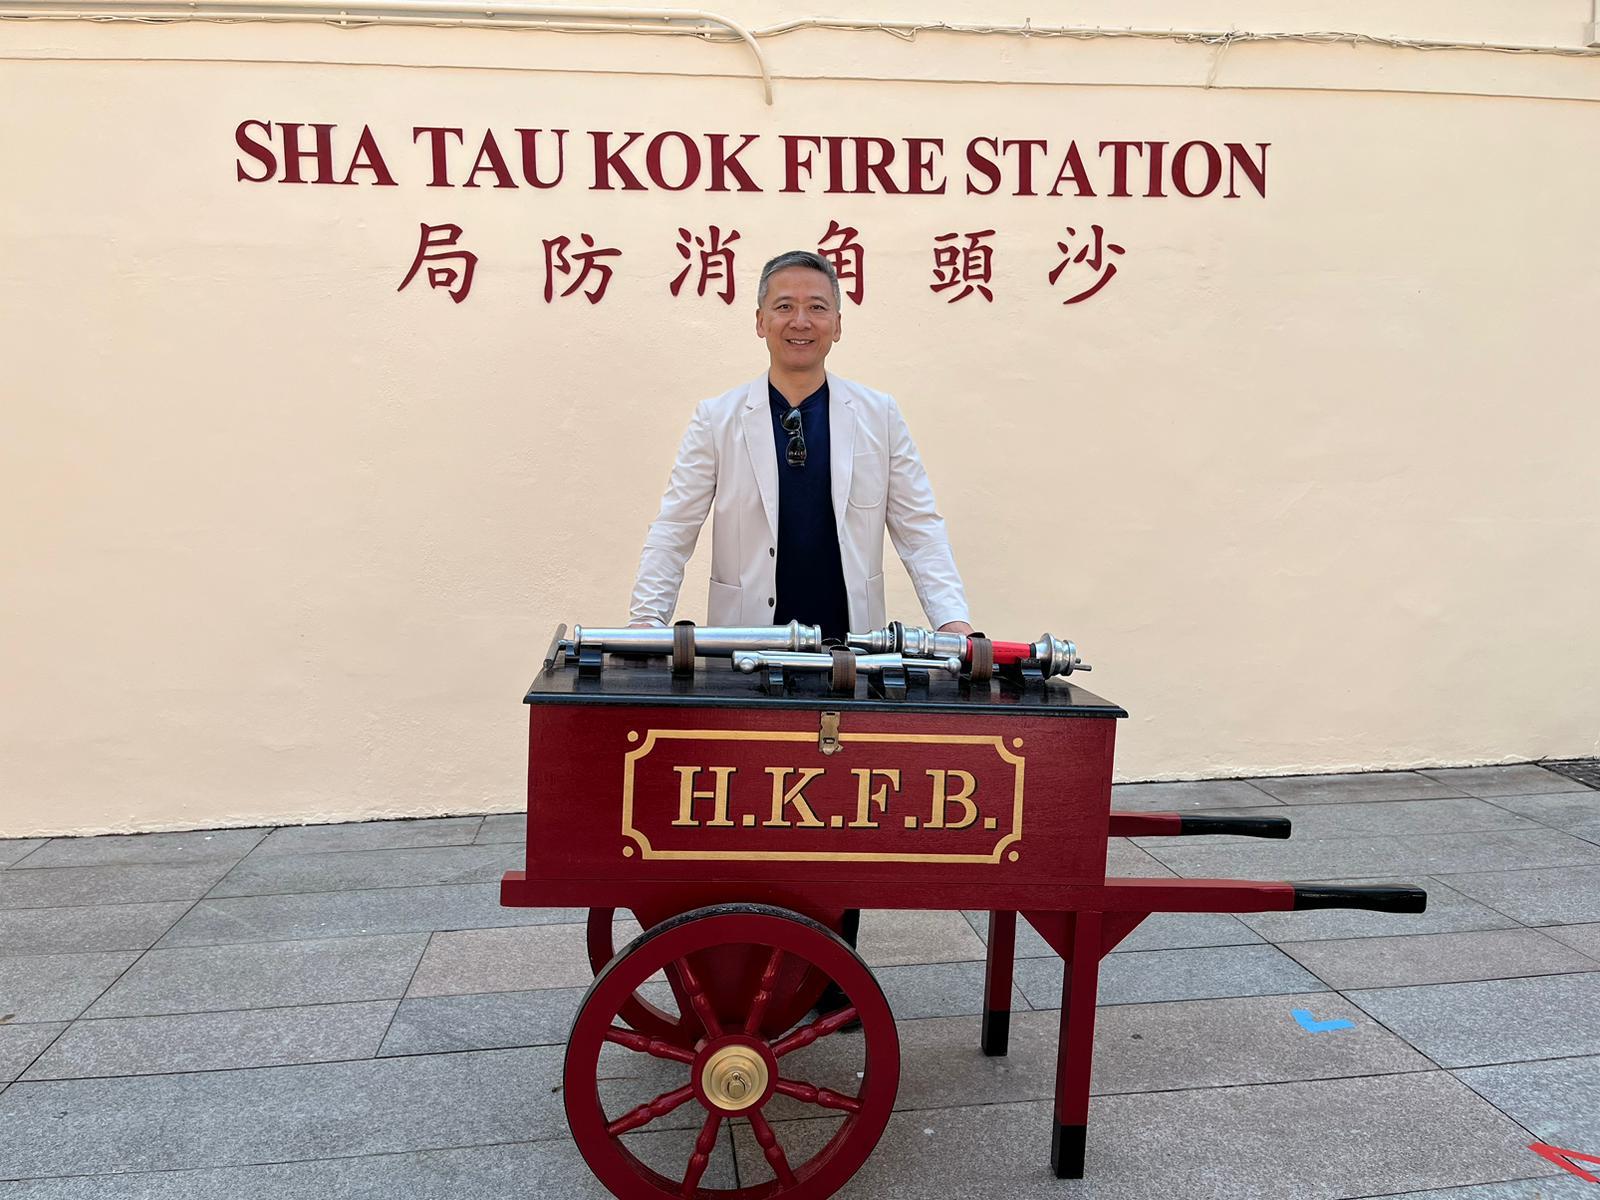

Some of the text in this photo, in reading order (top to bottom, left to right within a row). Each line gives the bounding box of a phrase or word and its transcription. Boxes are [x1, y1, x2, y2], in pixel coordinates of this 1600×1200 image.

[235, 119, 1272, 199] SHA TAU KOK FIRE STATION
[670, 764, 999, 830] H.K.F.B.
